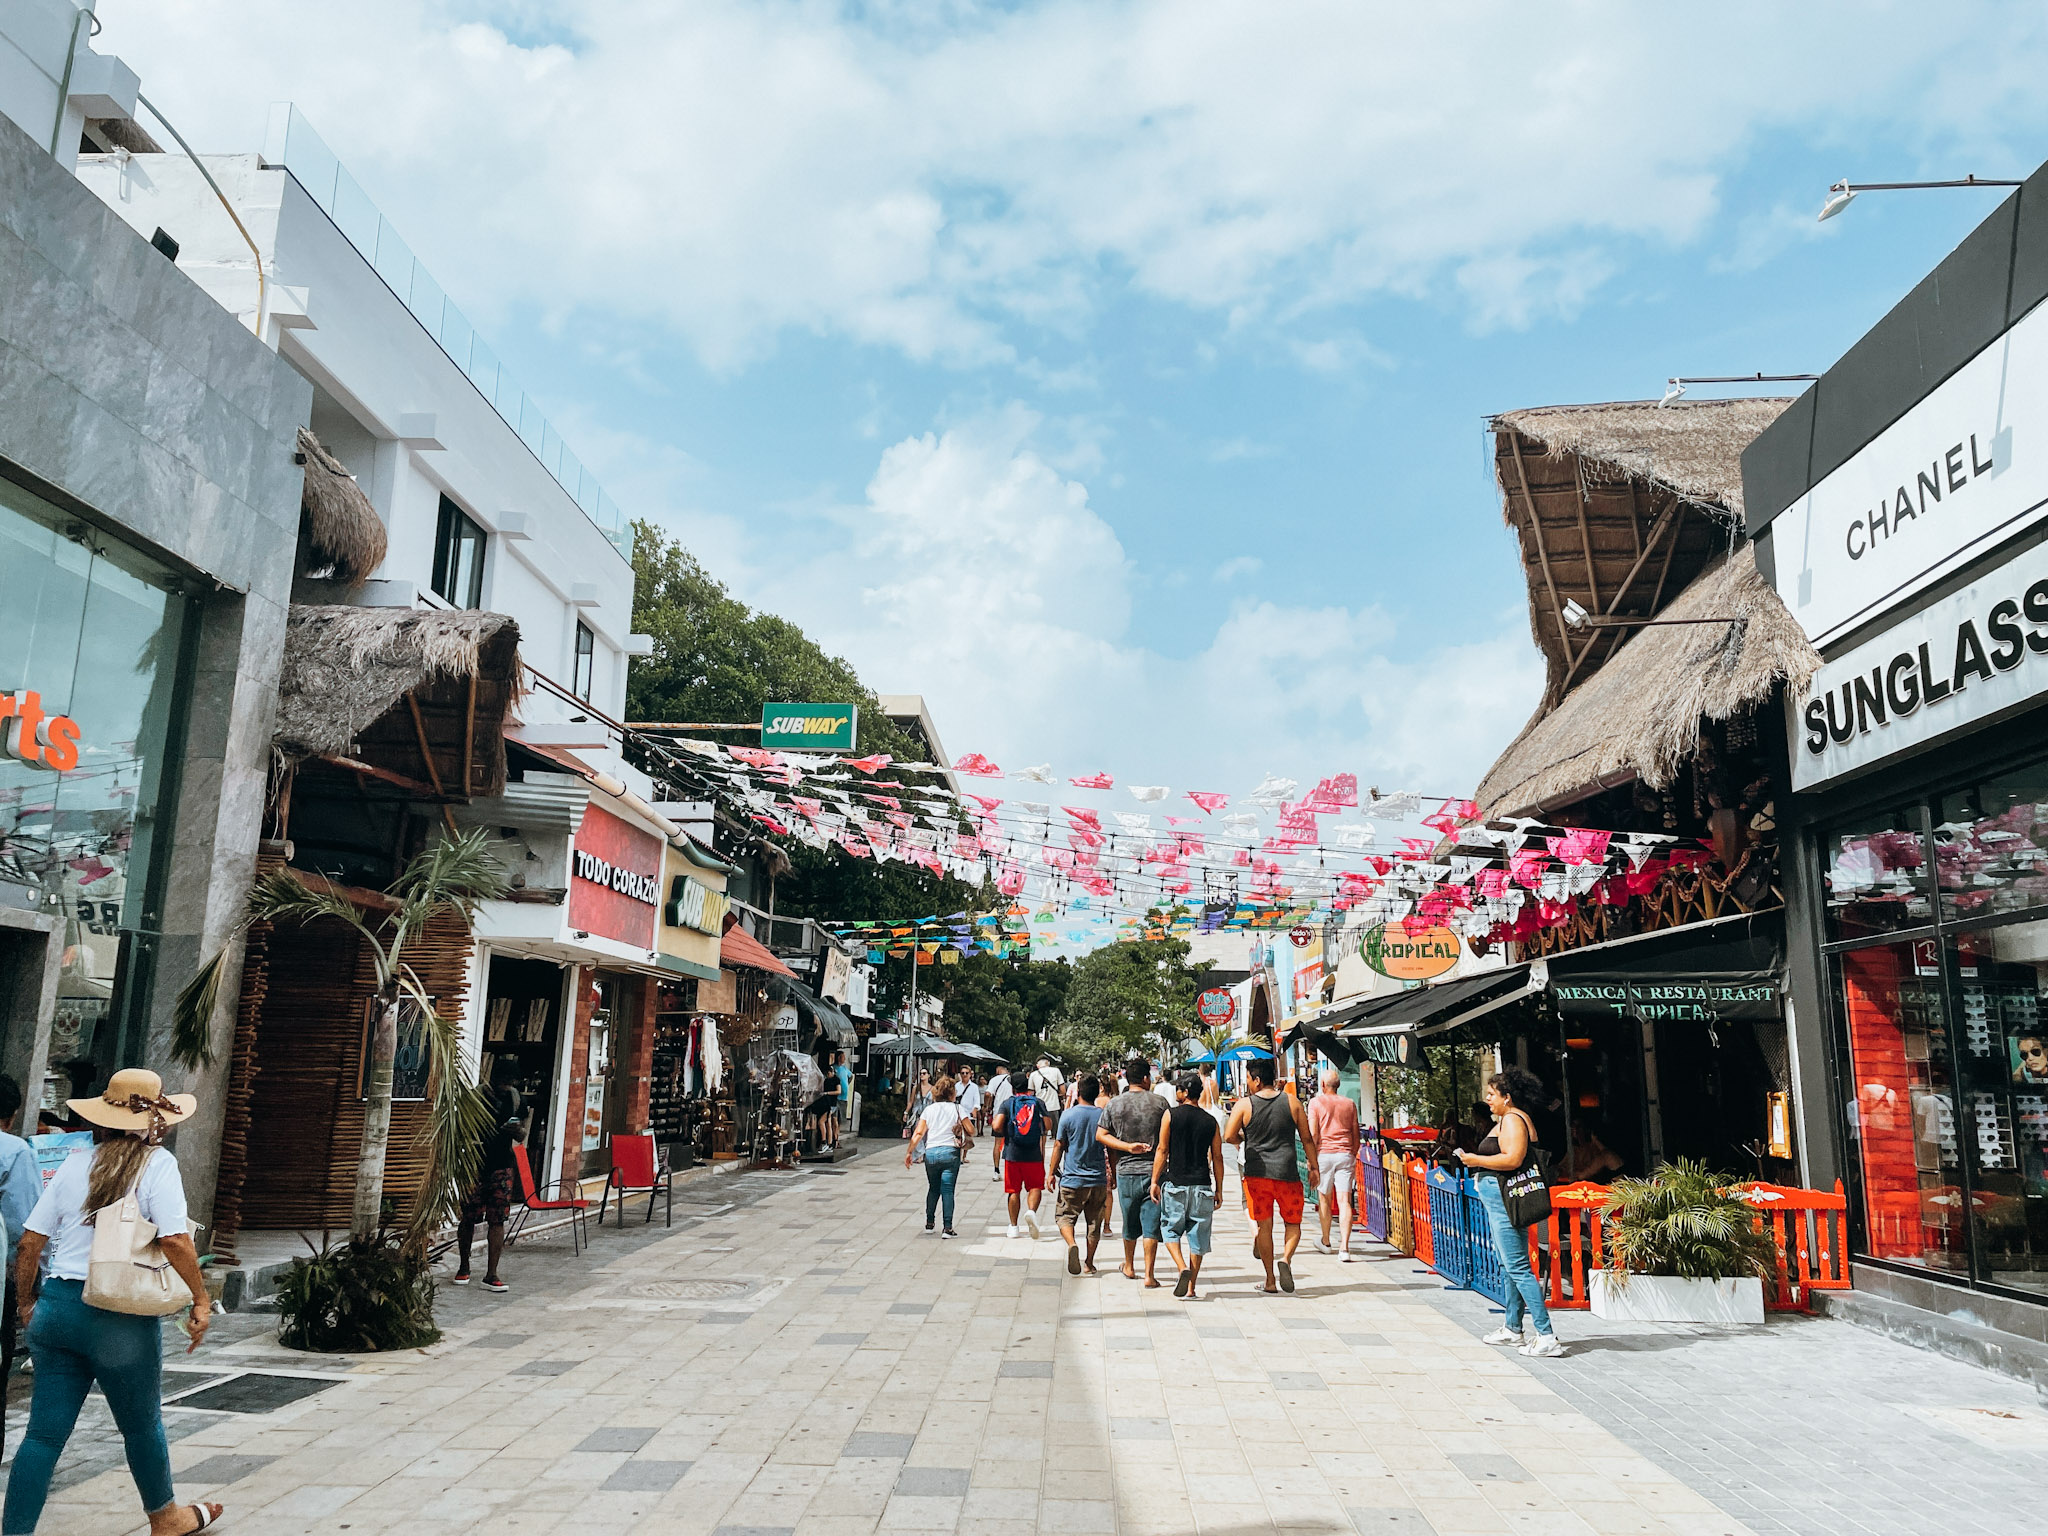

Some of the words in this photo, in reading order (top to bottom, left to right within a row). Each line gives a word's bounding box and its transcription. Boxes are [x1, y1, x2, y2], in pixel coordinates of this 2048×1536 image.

[1847, 433, 1994, 560] CHANEL
[1805, 577, 2048, 756] SUNGLASS
[765, 715, 848, 735] SUBWAY
[577, 850, 611, 886] TODO
[677, 877, 730, 937] SUBWAY
[1556, 986, 1642, 1000] MEXICAN
[1650, 986, 1775, 1001] RESTAURANT
[1610, 1003, 1719, 1020] TOPICA
[1526, 1164, 1541, 1178] thi
